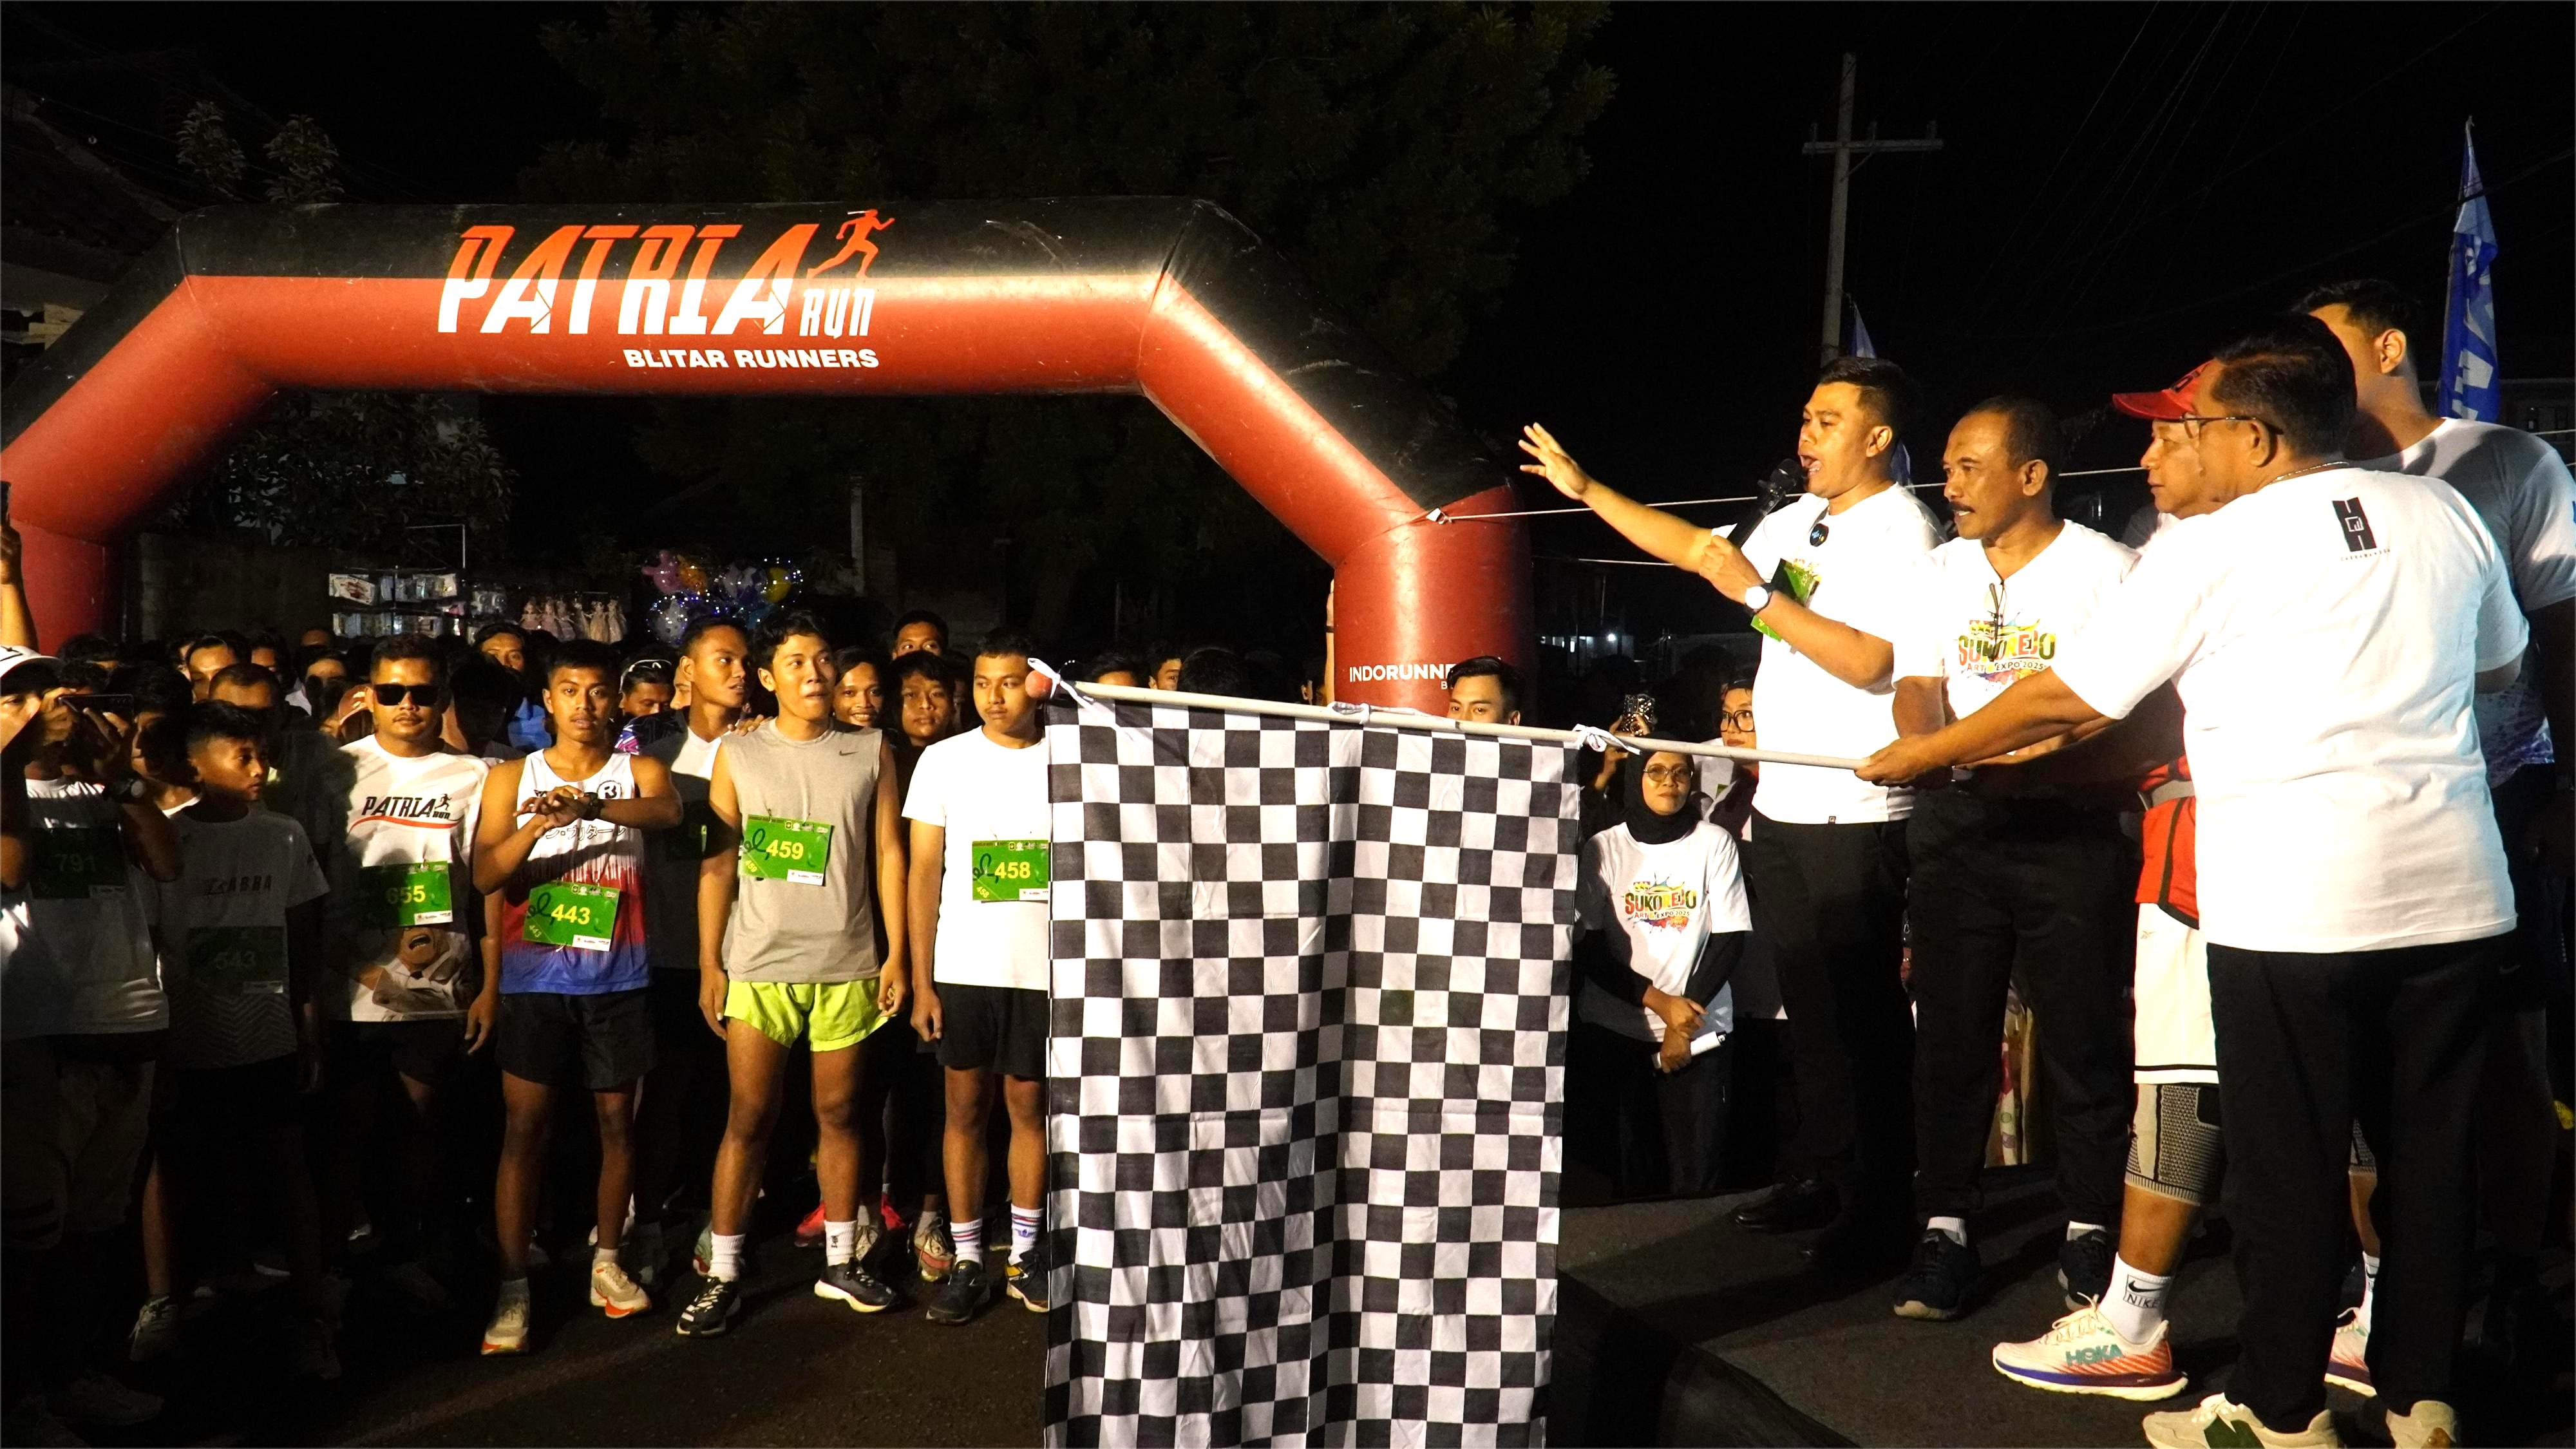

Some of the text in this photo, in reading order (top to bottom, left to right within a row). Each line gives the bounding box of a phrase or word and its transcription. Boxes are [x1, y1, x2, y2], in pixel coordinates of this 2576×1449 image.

[438, 224, 876, 339] PATRIA RUN
[623, 348, 879, 368] BLITAR RUNNERS
[1967, 663, 1985, 671] ART
[1996, 661, 2020, 671] EXPO
[361, 796, 437, 818] PATRIA
[766, 839, 804, 860] 459
[54, 853, 96, 872] 791
[745, 860, 758, 873] 459
[994, 861, 1030, 879] 458
[386, 885, 426, 904] 655
[976, 886, 989, 898] 458
[551, 904, 591, 925] 443
[529, 925, 542, 938] 443
[214, 949, 256, 969] 543
[2127, 1294, 2161, 1309] NIKE
[2065, 1344, 2123, 1366] HOKA
